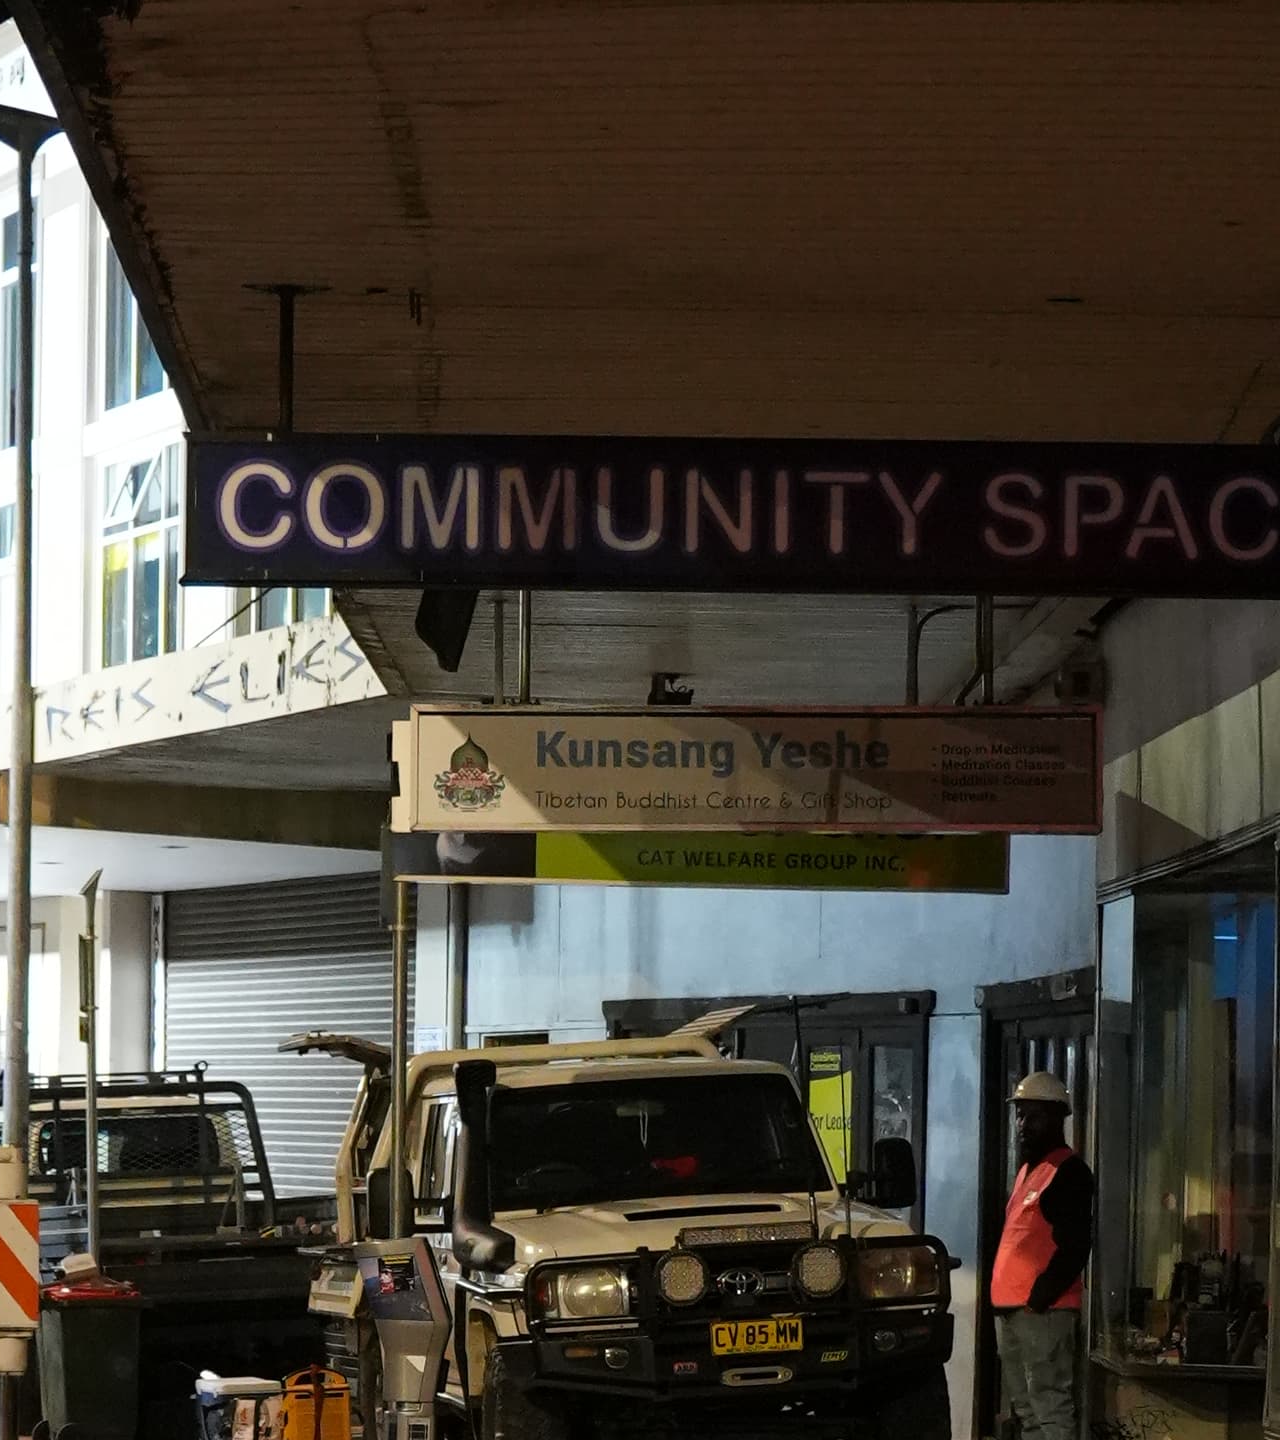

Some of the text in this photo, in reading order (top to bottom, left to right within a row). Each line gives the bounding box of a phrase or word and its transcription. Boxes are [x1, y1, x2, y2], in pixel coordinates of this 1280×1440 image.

[219, 463, 941, 556] COMMUNITY
[536, 730, 891, 778] Kunsang Yeshe
[941, 744, 972, 756] Drop
[975, 744, 987, 754] in
[942, 759, 1065, 770] Meditation Classes
[535, 791, 893, 816] Tibetan Buddhist Centre & Gift Shop
[637, 850, 906, 873] CAT WELFARE GROUP INC.
[715, 1324, 738, 1348] CV
[745, 1325, 769, 1346] 85
[776, 1322, 799, 1344] MW
